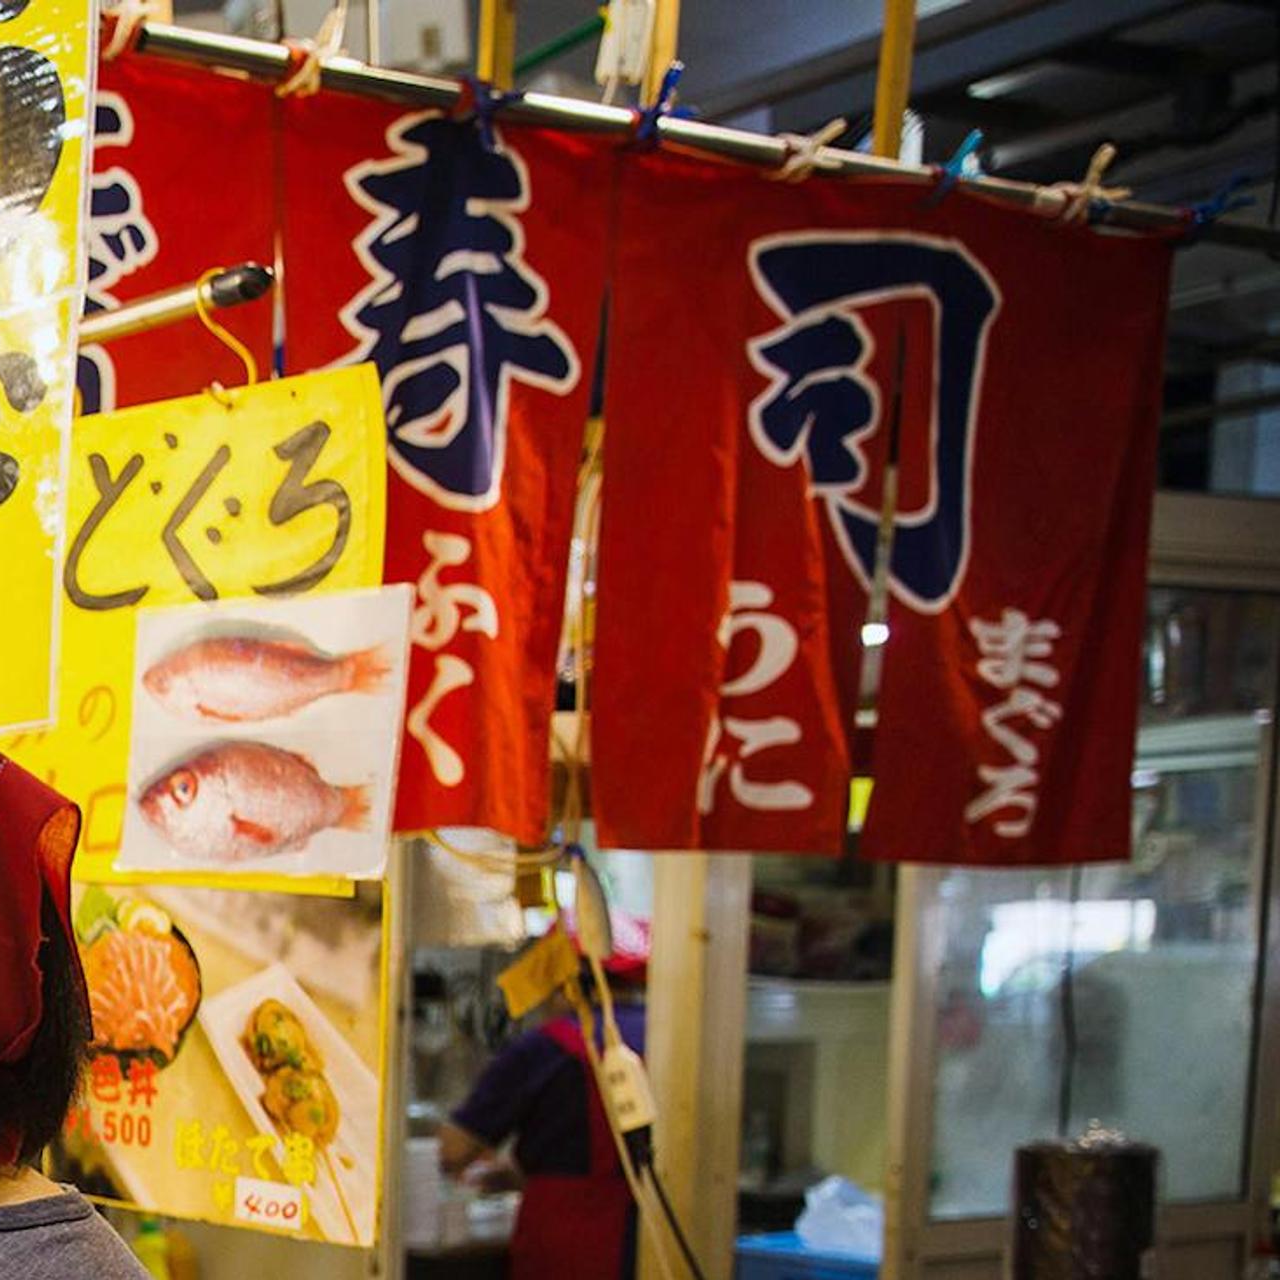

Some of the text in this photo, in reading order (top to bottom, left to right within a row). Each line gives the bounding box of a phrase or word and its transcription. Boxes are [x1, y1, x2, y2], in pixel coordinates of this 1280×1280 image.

[409, 529, 499, 788] ふく
[964, 606, 1063, 838] まぐろ
